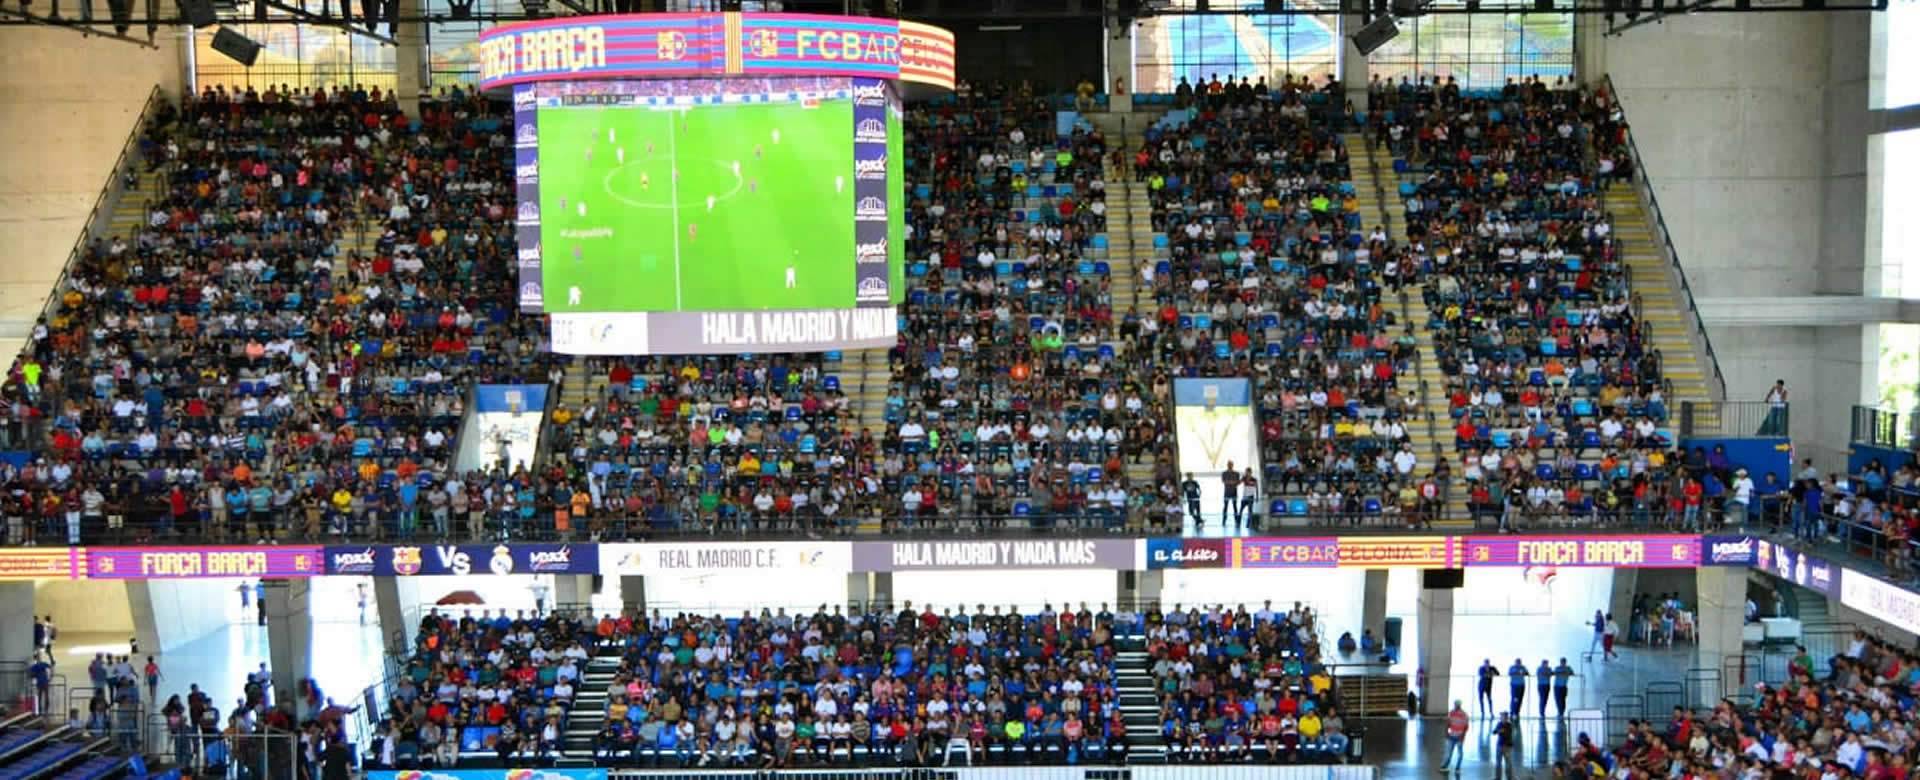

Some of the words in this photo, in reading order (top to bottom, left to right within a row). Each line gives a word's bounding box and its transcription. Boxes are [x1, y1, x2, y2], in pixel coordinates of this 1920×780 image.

[522, 27, 605, 72] BARÇA
[702, 312, 757, 345] HALA
[761, 309, 836, 345] MADRID
[839, 309, 849, 341] Y
[141, 552, 201, 576] FORÇA
[207, 552, 268, 575] BARÇA
[659, 549, 692, 569] REAL
[697, 549, 752, 569] MADRID
[756, 547, 781, 569] C.F.
[892, 541, 933, 566] HALA
[935, 541, 996, 566] MADRID
[1000, 541, 1010, 565] Y
[1014, 540, 1056, 565] NADA
[1154, 549, 1169, 561] EL
[1518, 541, 1578, 565] FORÇA
[1584, 541, 1644, 565] BARÇA
